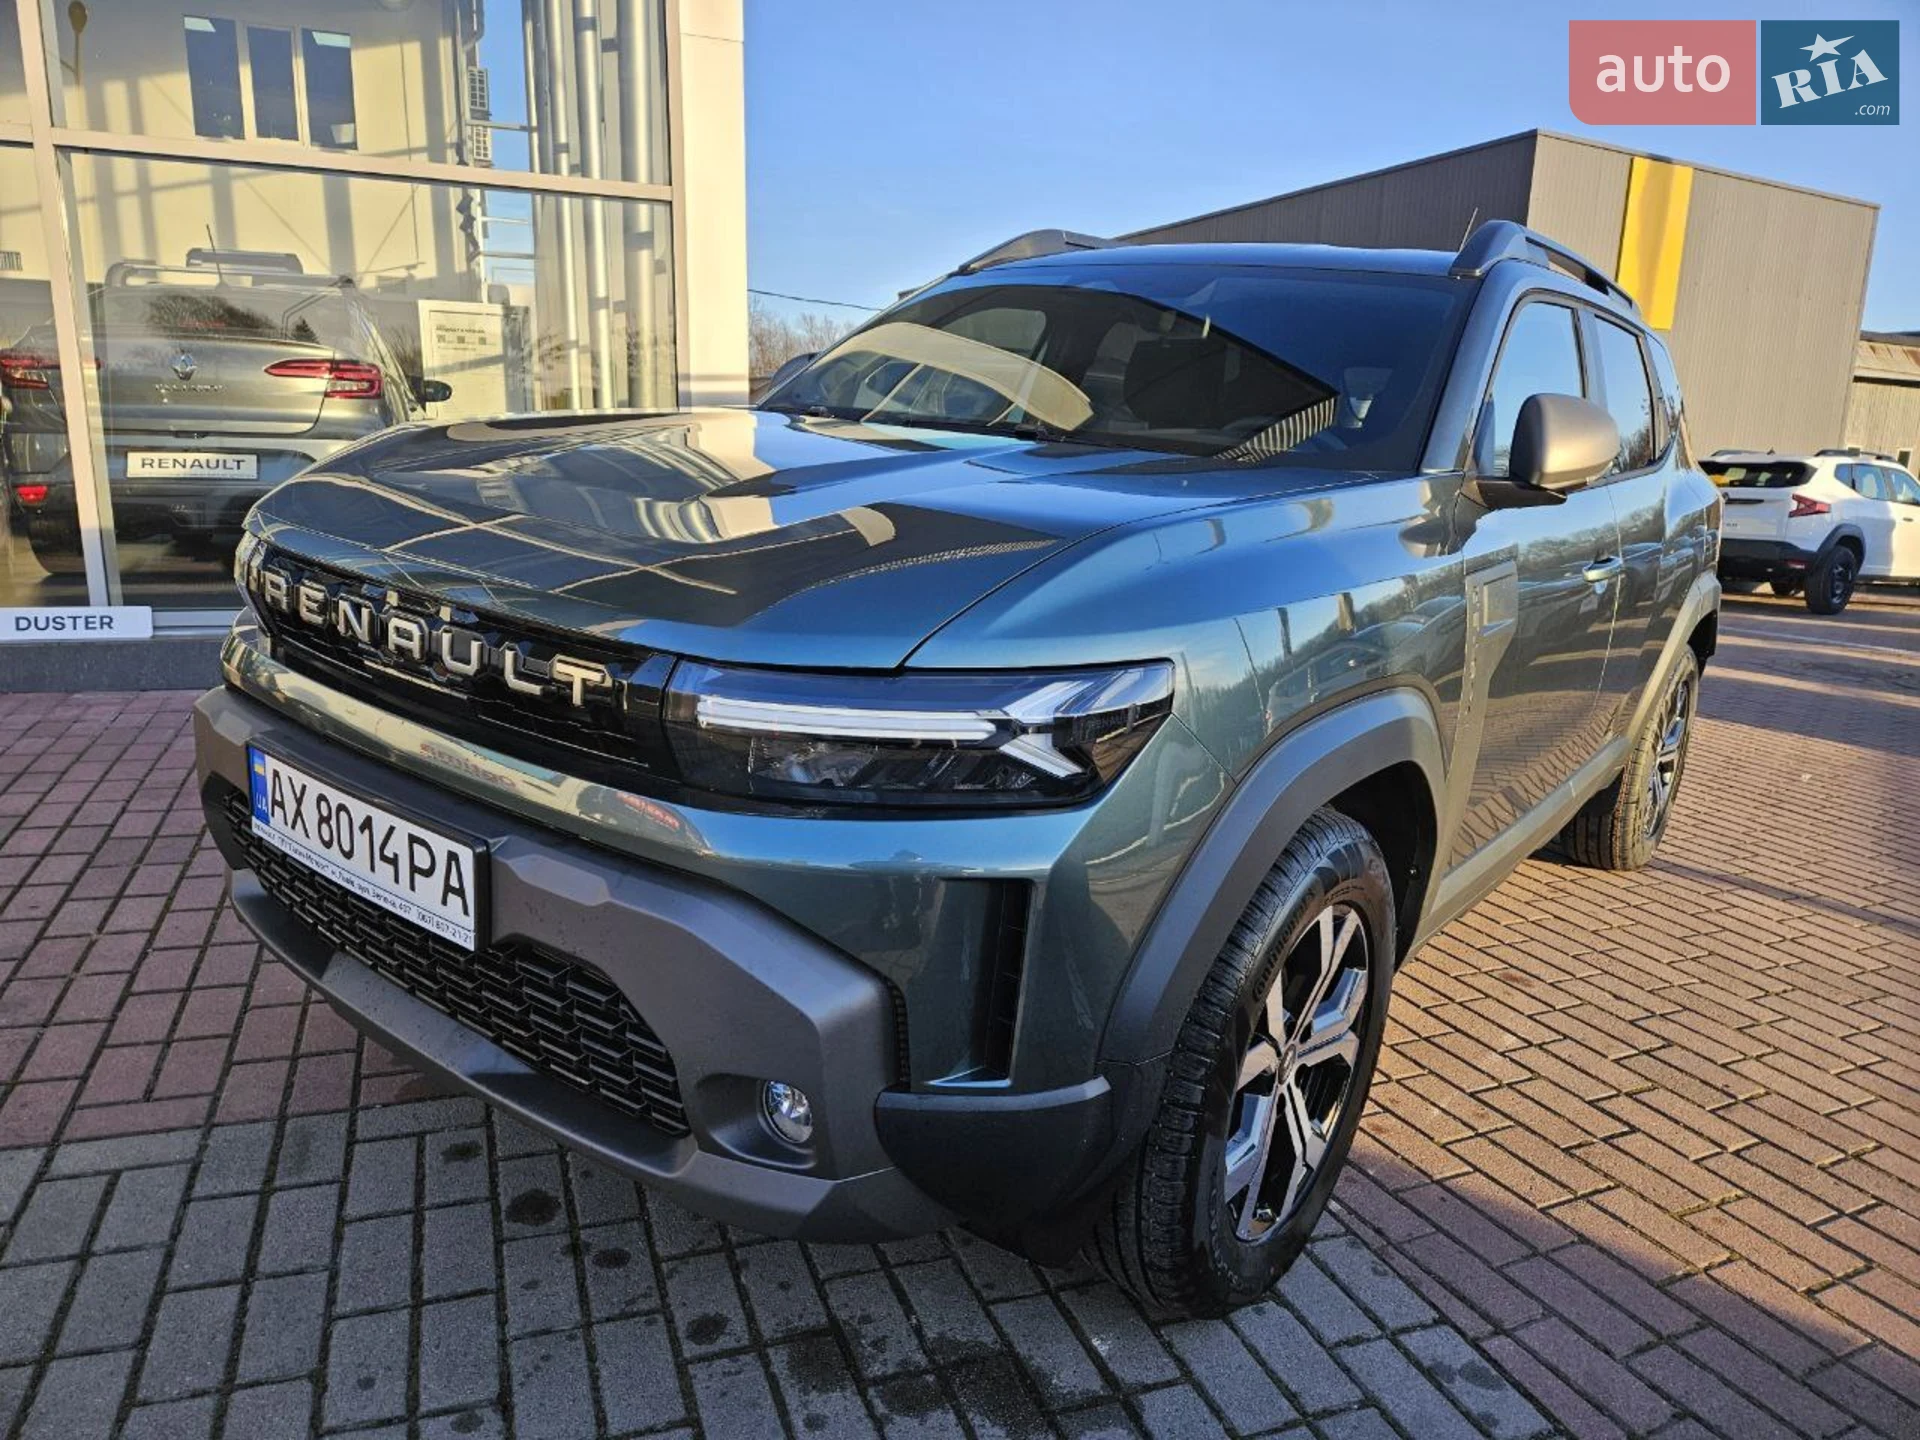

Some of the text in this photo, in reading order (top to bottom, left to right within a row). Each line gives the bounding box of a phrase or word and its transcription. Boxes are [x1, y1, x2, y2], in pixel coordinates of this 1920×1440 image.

[141, 458, 246, 470] RENAULT
[15, 615, 114, 631] DUSTER
[264, 568, 608, 706] RENAULT
[256, 794, 268, 813] UA
